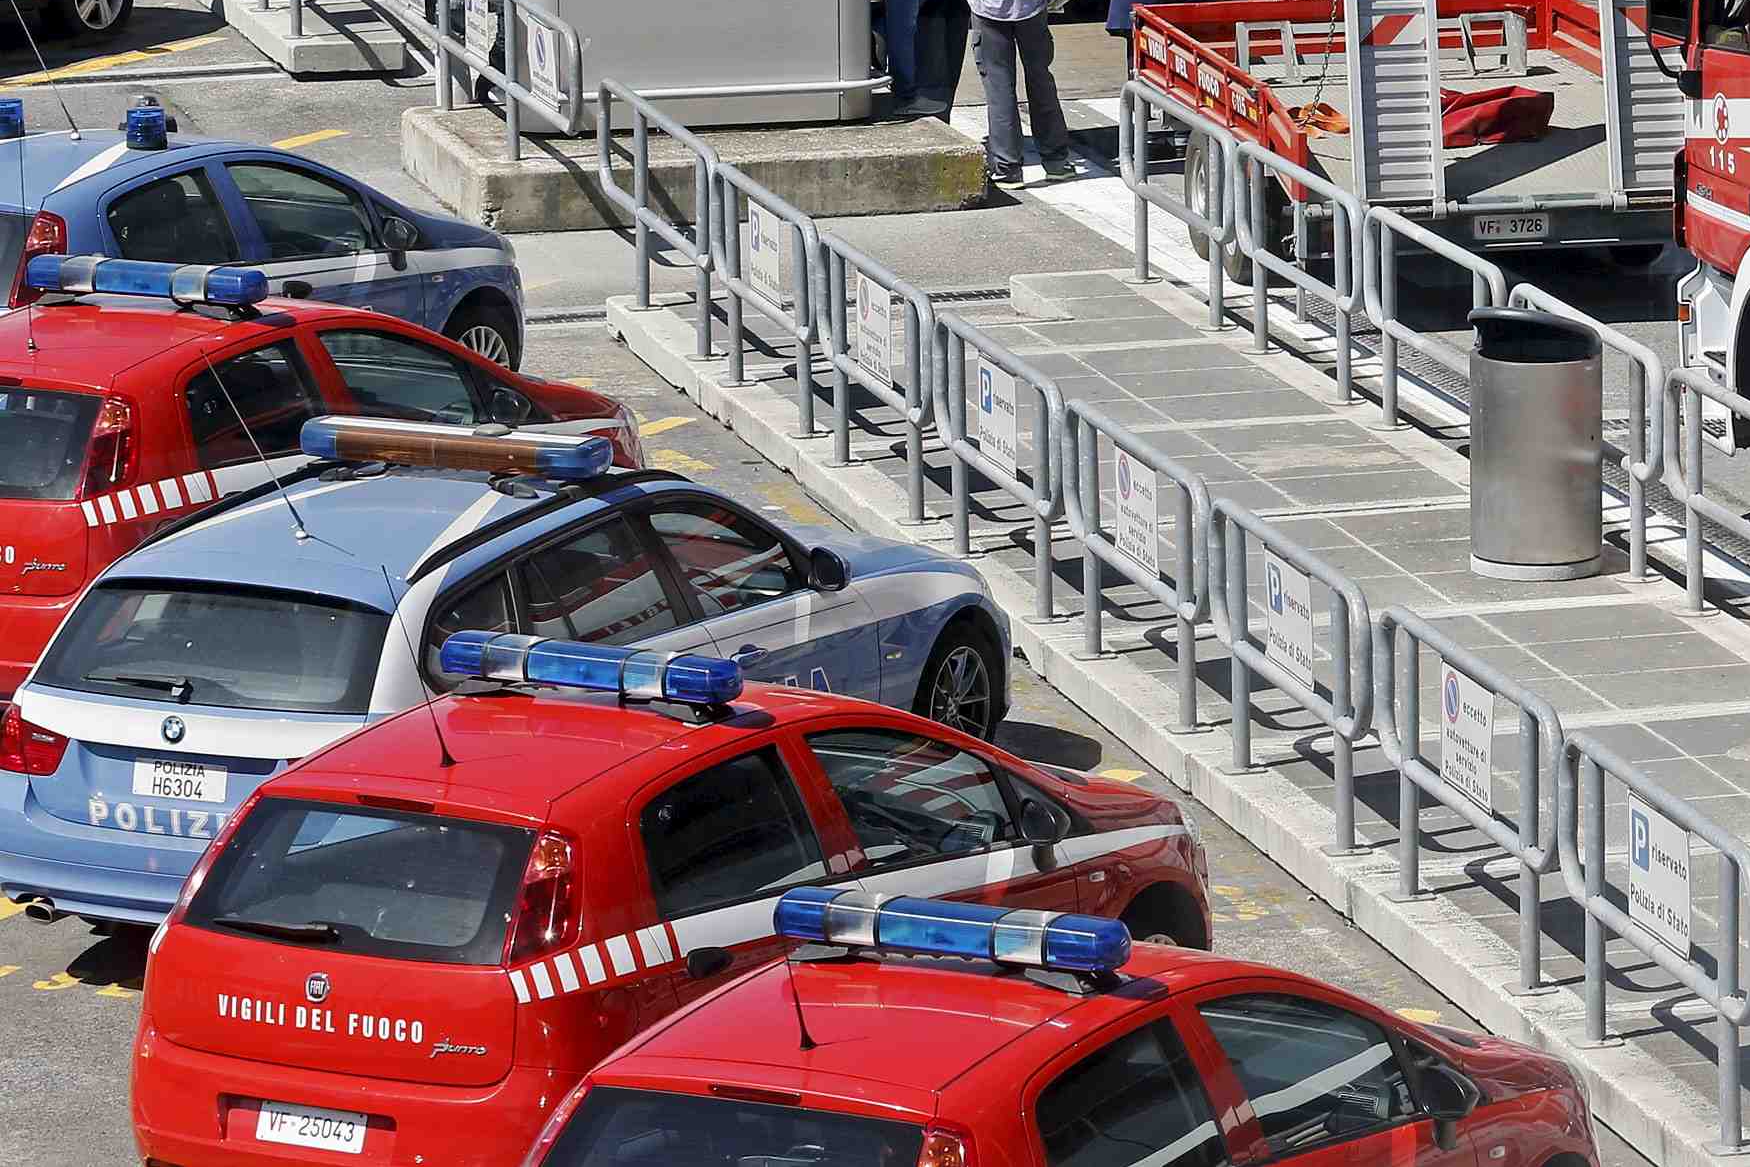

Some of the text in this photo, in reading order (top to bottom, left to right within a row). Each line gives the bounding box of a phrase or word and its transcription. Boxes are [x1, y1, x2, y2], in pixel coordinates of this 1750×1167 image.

[1147, 35, 1167, 65] VIGILI
[1174, 54, 1188, 79] DEL
[1197, 69, 1220, 98] FUOCO
[1709, 145, 1736, 175] 115
[1509, 218, 1543, 234] 3726
[992, 391, 1015, 417] riservato
[1133, 479, 1153, 502] eccetto
[1119, 531, 1136, 555] Polizia
[1142, 547, 1156, 570] Stato
[1283, 590, 1310, 622] riservato
[1269, 626, 1312, 672] Polizia di Stato
[1463, 701, 1487, 727] eccetto
[1446, 727, 1487, 764] autovetture di
[153, 760, 206, 778] POLIZIA
[1455, 751, 1478, 776] servizio
[152, 777, 203, 799] H6304
[1444, 759, 1489, 803] Polizia di Stato
[88, 797, 228, 837] POLIZI
[1651, 843, 1688, 880] riservato
[1630, 882, 1689, 938] Polizia di Stato
[309, 978, 326, 995] FIAT
[218, 993, 425, 1044] VIGILI DEL FUOCO
[269, 1110, 356, 1143] VF 25043
